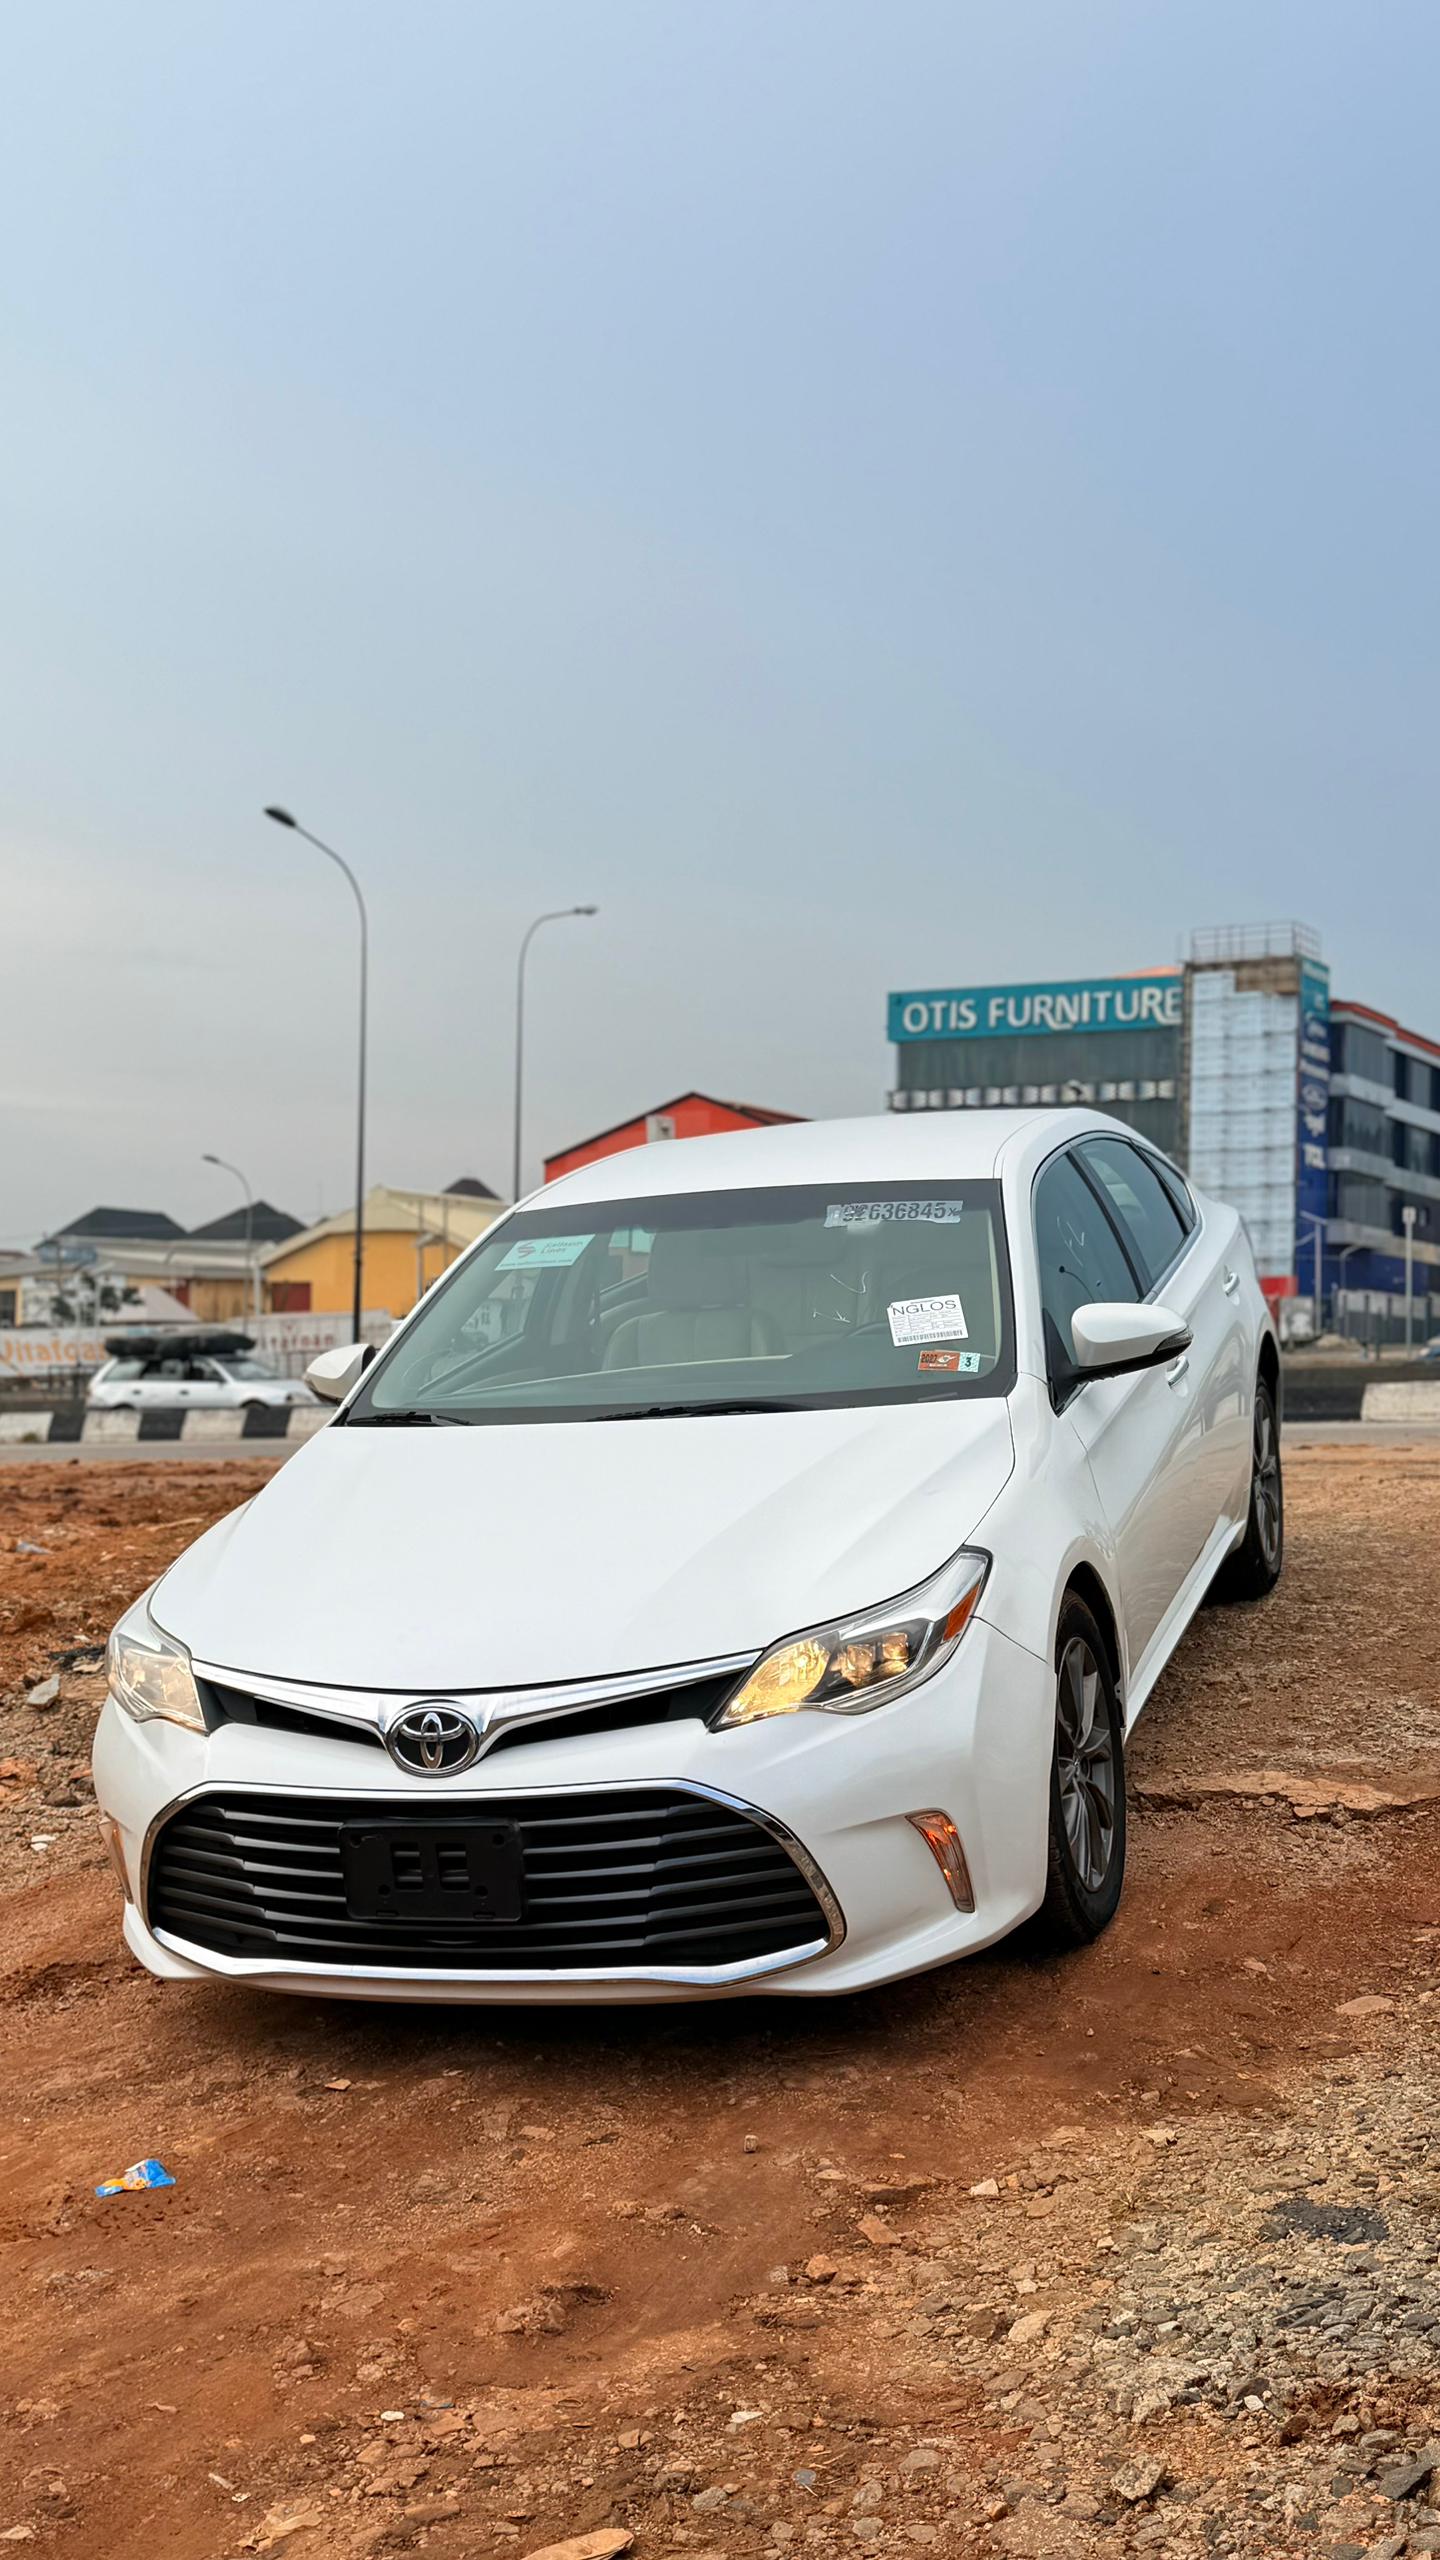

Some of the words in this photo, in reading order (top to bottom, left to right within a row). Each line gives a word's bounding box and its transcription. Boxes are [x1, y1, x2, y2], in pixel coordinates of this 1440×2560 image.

[903, 999, 977, 1033] OTIS
[988, 986, 1184, 1030] FURNITURE
[892, 1299, 957, 1316] NGLOS
[964, 1356, 973, 1368] 3
